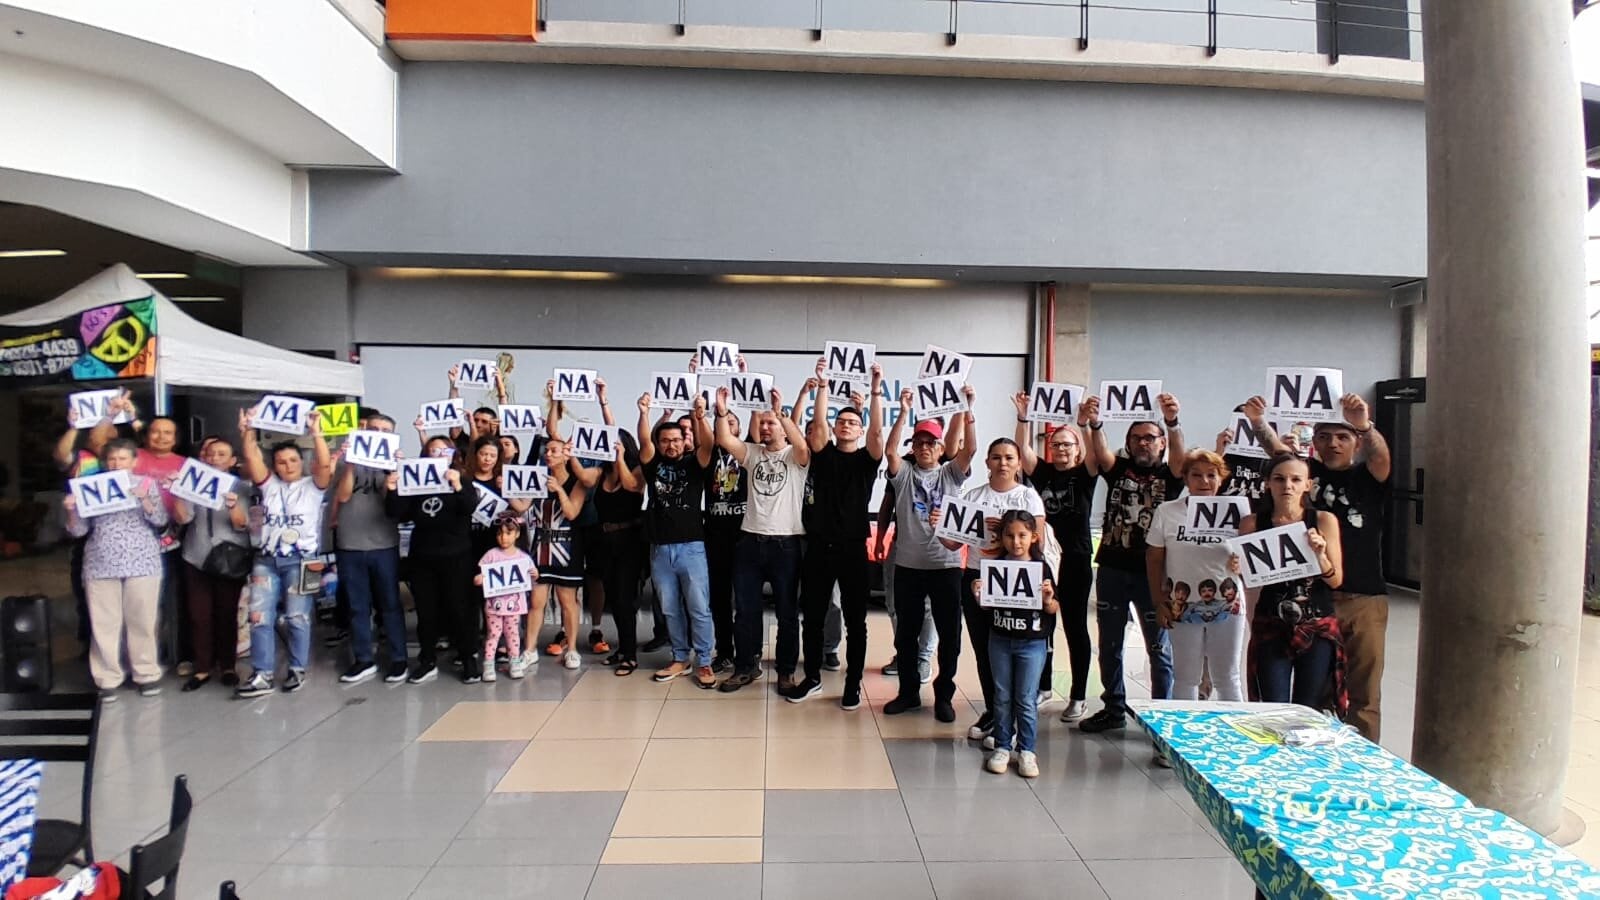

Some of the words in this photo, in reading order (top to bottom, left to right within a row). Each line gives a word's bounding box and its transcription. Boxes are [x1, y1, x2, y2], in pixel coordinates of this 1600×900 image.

[700, 346, 732, 366] NA
[828, 347, 866, 373] NA
[925, 351, 960, 374] NA
[460, 363, 488, 383] NA
[558, 373, 590, 393] NA
[655, 377, 689, 400] NA
[731, 378, 765, 402] NA
[918, 380, 960, 409] NA
[1106, 385, 1152, 411] NA
[1273, 374, 1333, 409] NA
[260, 400, 299, 424] NA
[425, 403, 457, 421] NA
[1033, 387, 1072, 415] NA
[318, 405, 353, 428] NA
[504, 409, 536, 428] NA
[354, 435, 391, 460] NA
[576, 427, 610, 452] NA
[181, 466, 219, 499] NA
[403, 464, 441, 486] NA
[508, 470, 541, 491] NA
[755, 465, 784, 485] BEATLES
[79, 478, 126, 506] NA
[943, 502, 985, 538] NA
[1193, 503, 1241, 529] NA
[1241, 533, 1307, 575] NA
[488, 565, 525, 588] NA
[987, 566, 1034, 597] NA
[994, 609, 1027, 630] BEATLES
